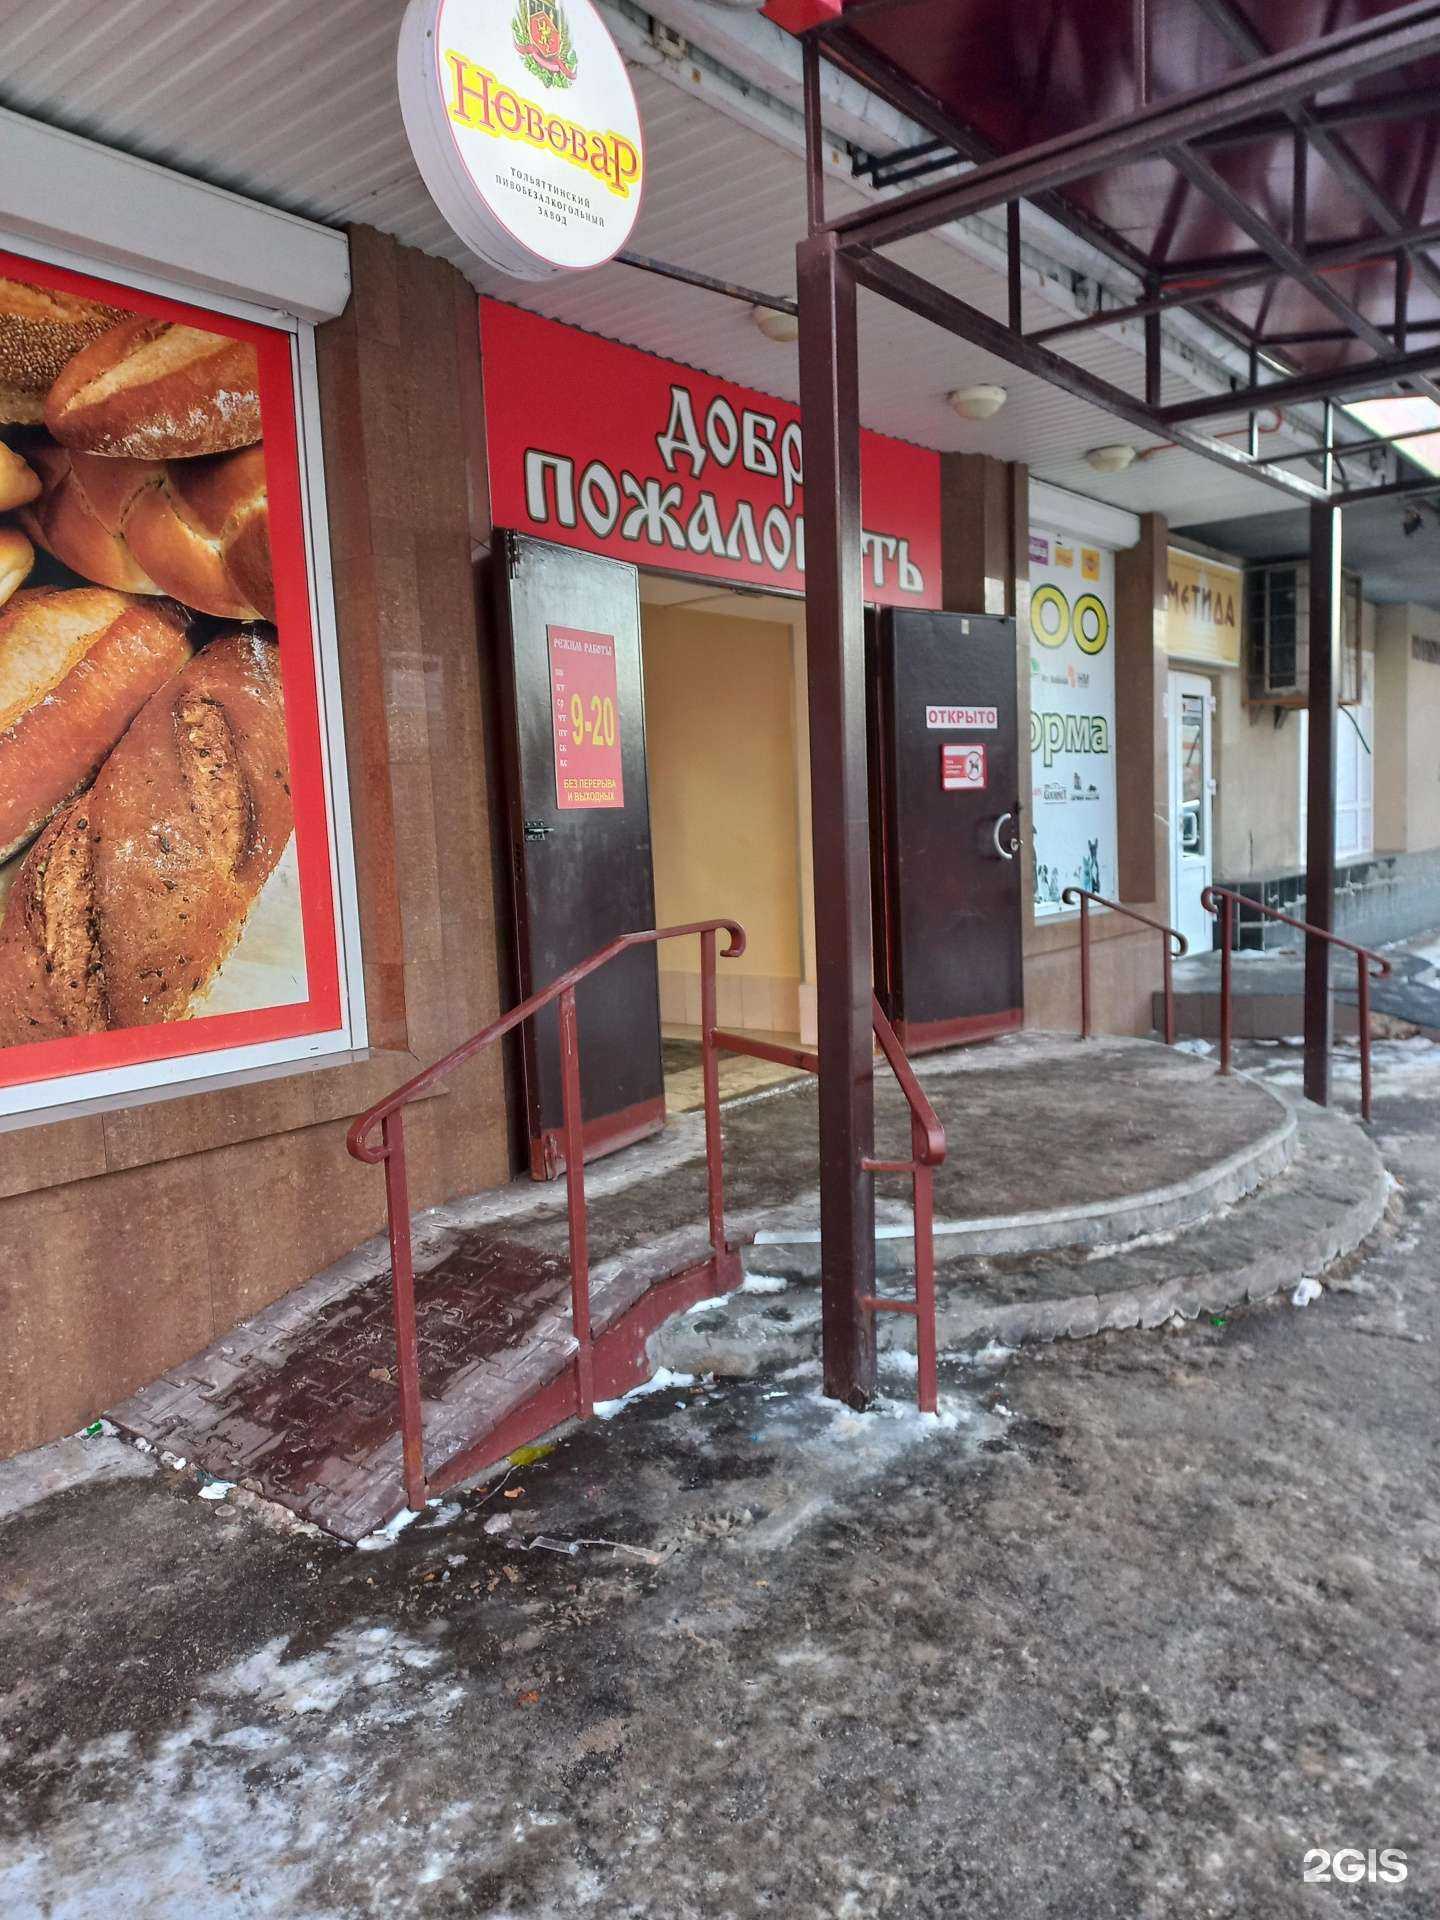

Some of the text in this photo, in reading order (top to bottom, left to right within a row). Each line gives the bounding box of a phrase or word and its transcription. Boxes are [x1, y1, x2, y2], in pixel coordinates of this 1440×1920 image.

[495, 174, 605, 228] ПИВОБЕЗАЛКОГОЛЬНЫЙ
[510, 166, 591, 209] ТОЛЬЯТТИНСКИЙ
[537, 206, 568, 227] ЗАВОД
[655, 384, 804, 509] ДОБР
[524, 447, 926, 594] ПОЖАЛОТЬ
[553, 637, 613, 657] РЕЖИМ РАБОТЫ
[570, 693, 615, 747] 9-20
[928, 710, 996, 725] ОТКРЫТО
[563, 778, 577, 789] БЕЗ
